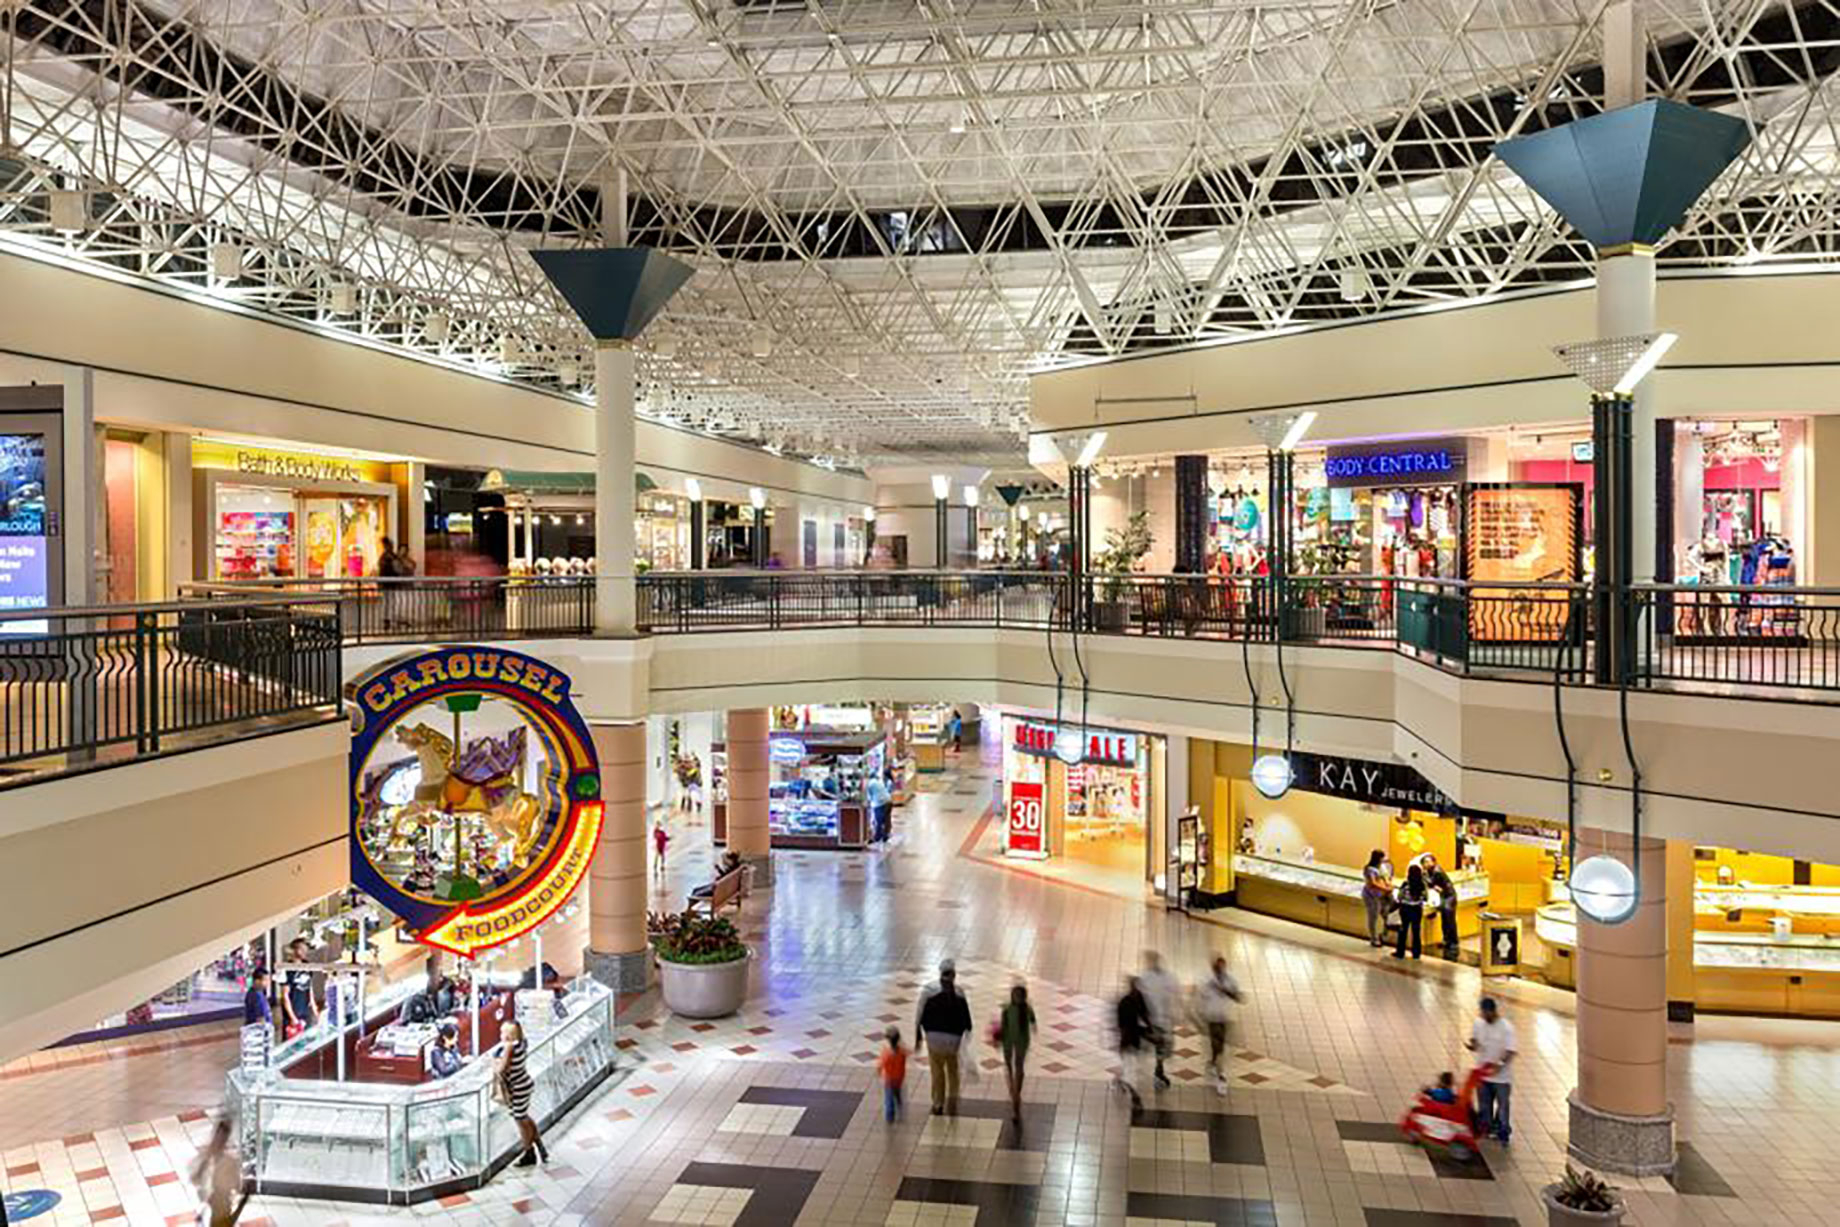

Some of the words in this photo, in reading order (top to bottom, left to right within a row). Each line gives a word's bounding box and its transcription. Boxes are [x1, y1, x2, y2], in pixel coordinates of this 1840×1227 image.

[1327, 457, 1364, 476] BODY
[1368, 451, 1451, 473] CENTRAL
[364, 653, 563, 712] CAROUSEL
[1084, 735, 1126, 761] ALE
[1319, 761, 1379, 796] KAY
[1012, 800, 1040, 830] 30
[455, 849, 582, 941] FOODCOURT
